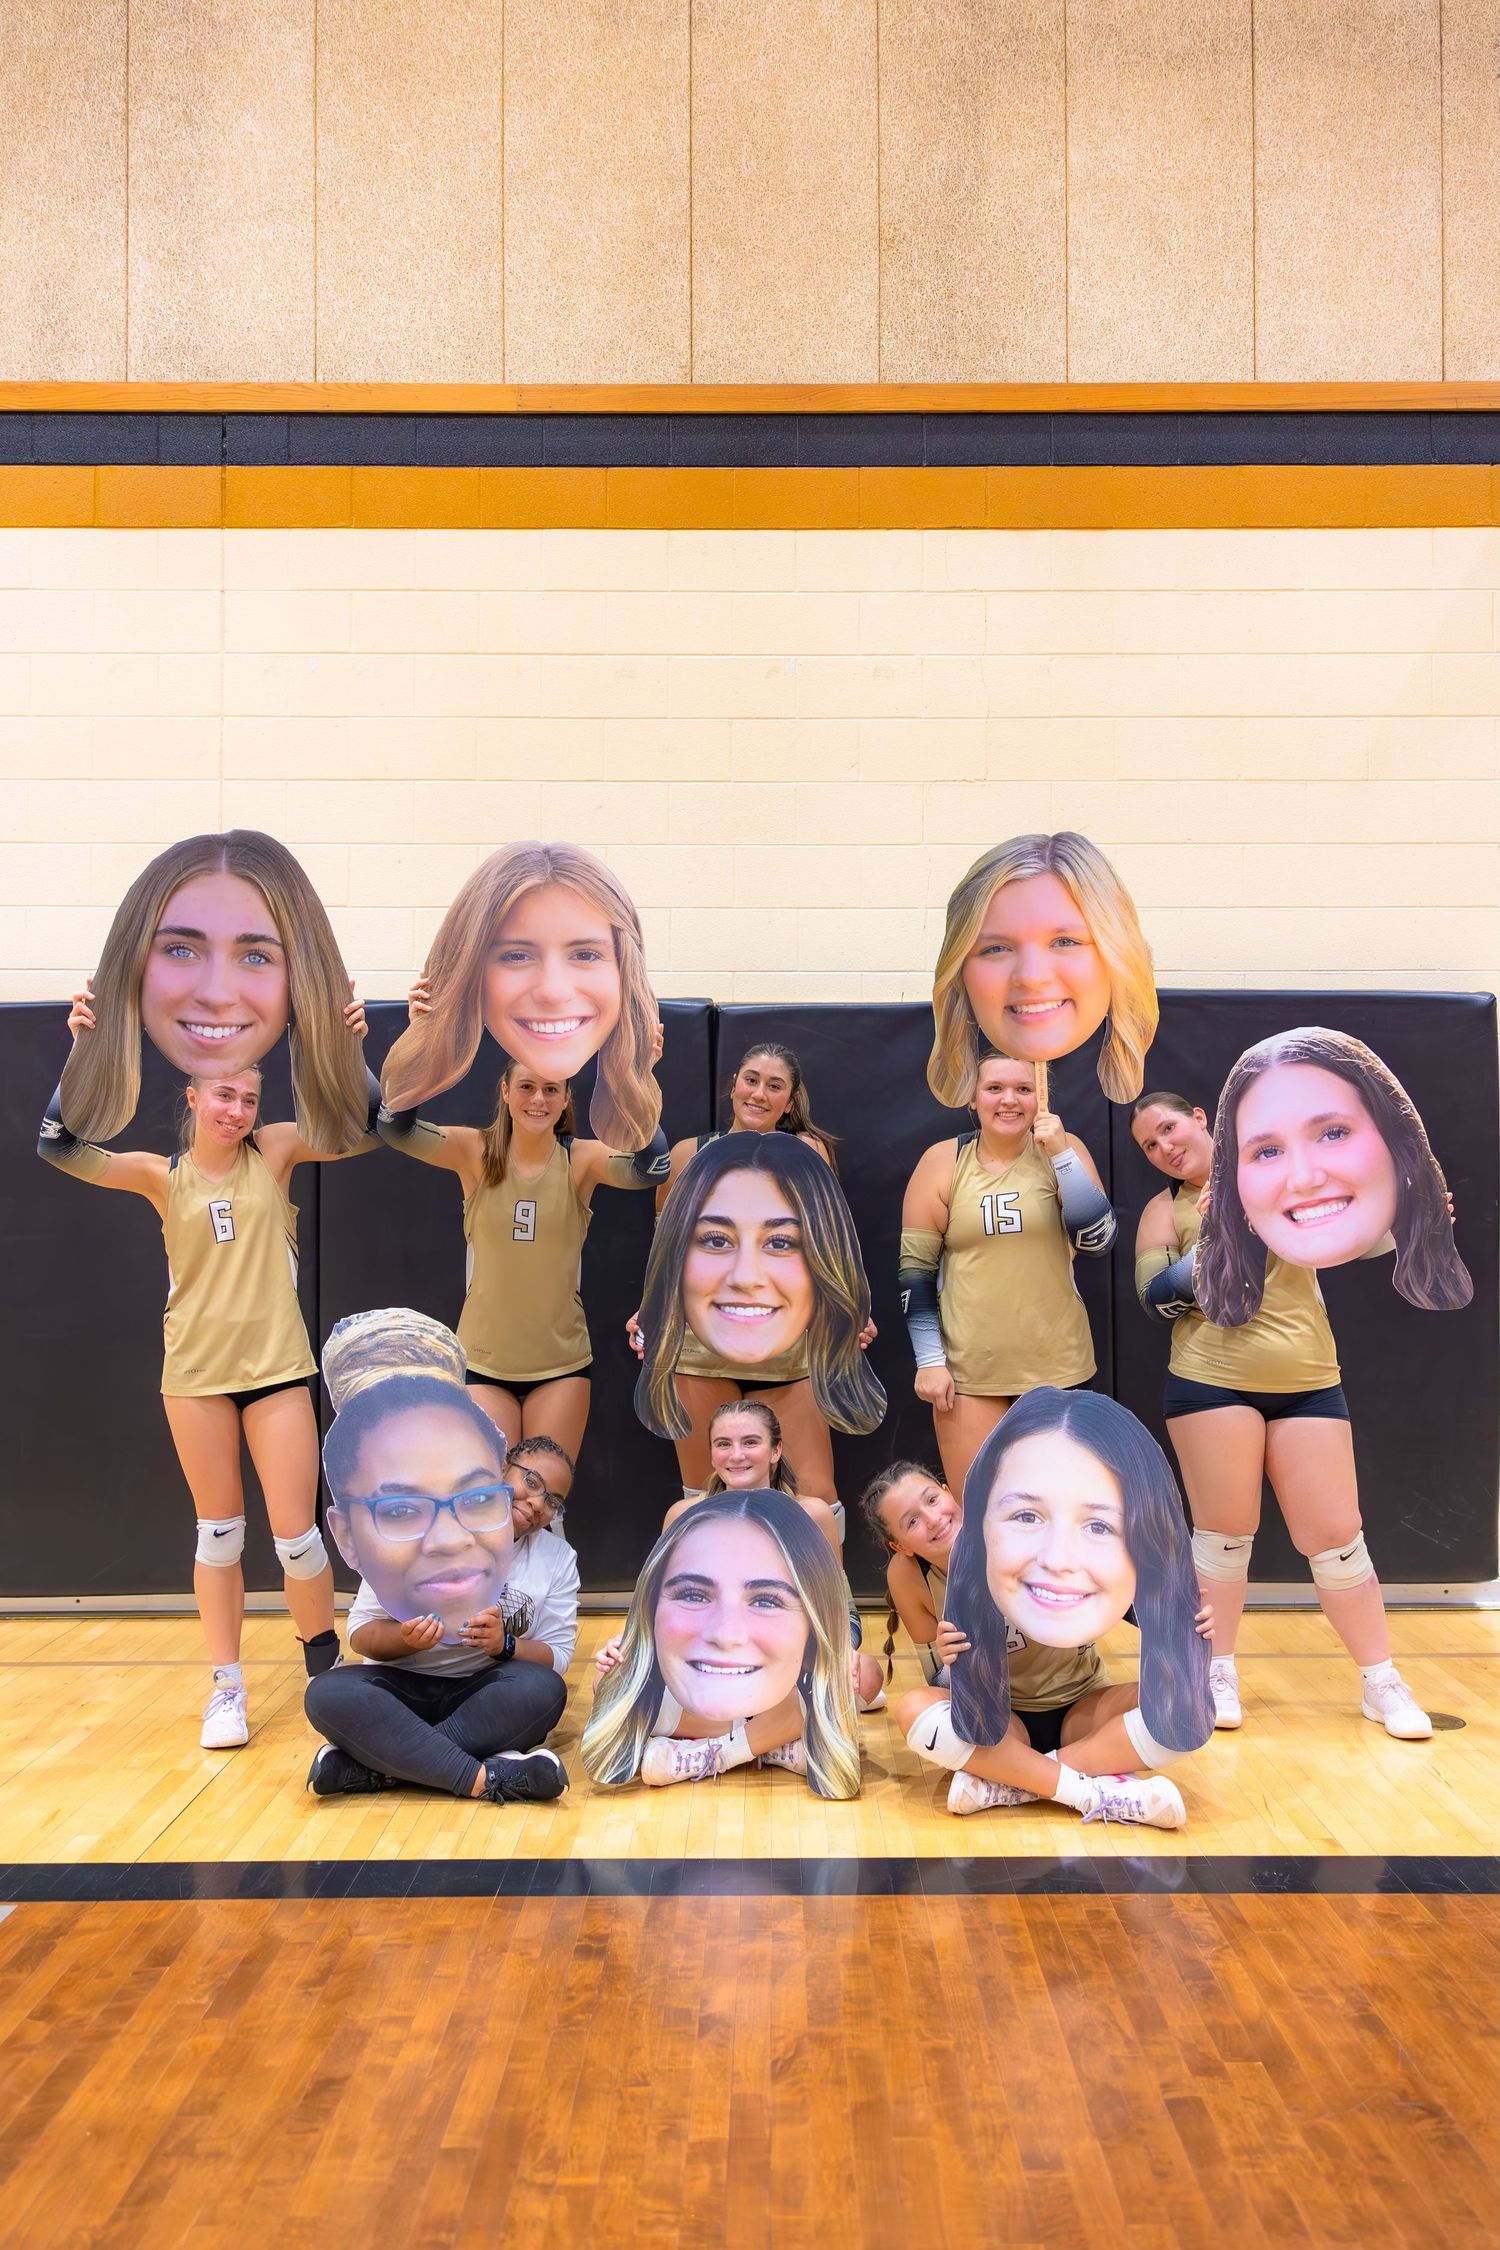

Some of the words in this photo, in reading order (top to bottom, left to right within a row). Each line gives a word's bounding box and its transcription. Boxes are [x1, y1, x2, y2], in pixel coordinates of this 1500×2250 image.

[208, 1199, 236, 1244] 6
[512, 1199, 537, 1241] 9
[980, 1191, 1023, 1236] 15
